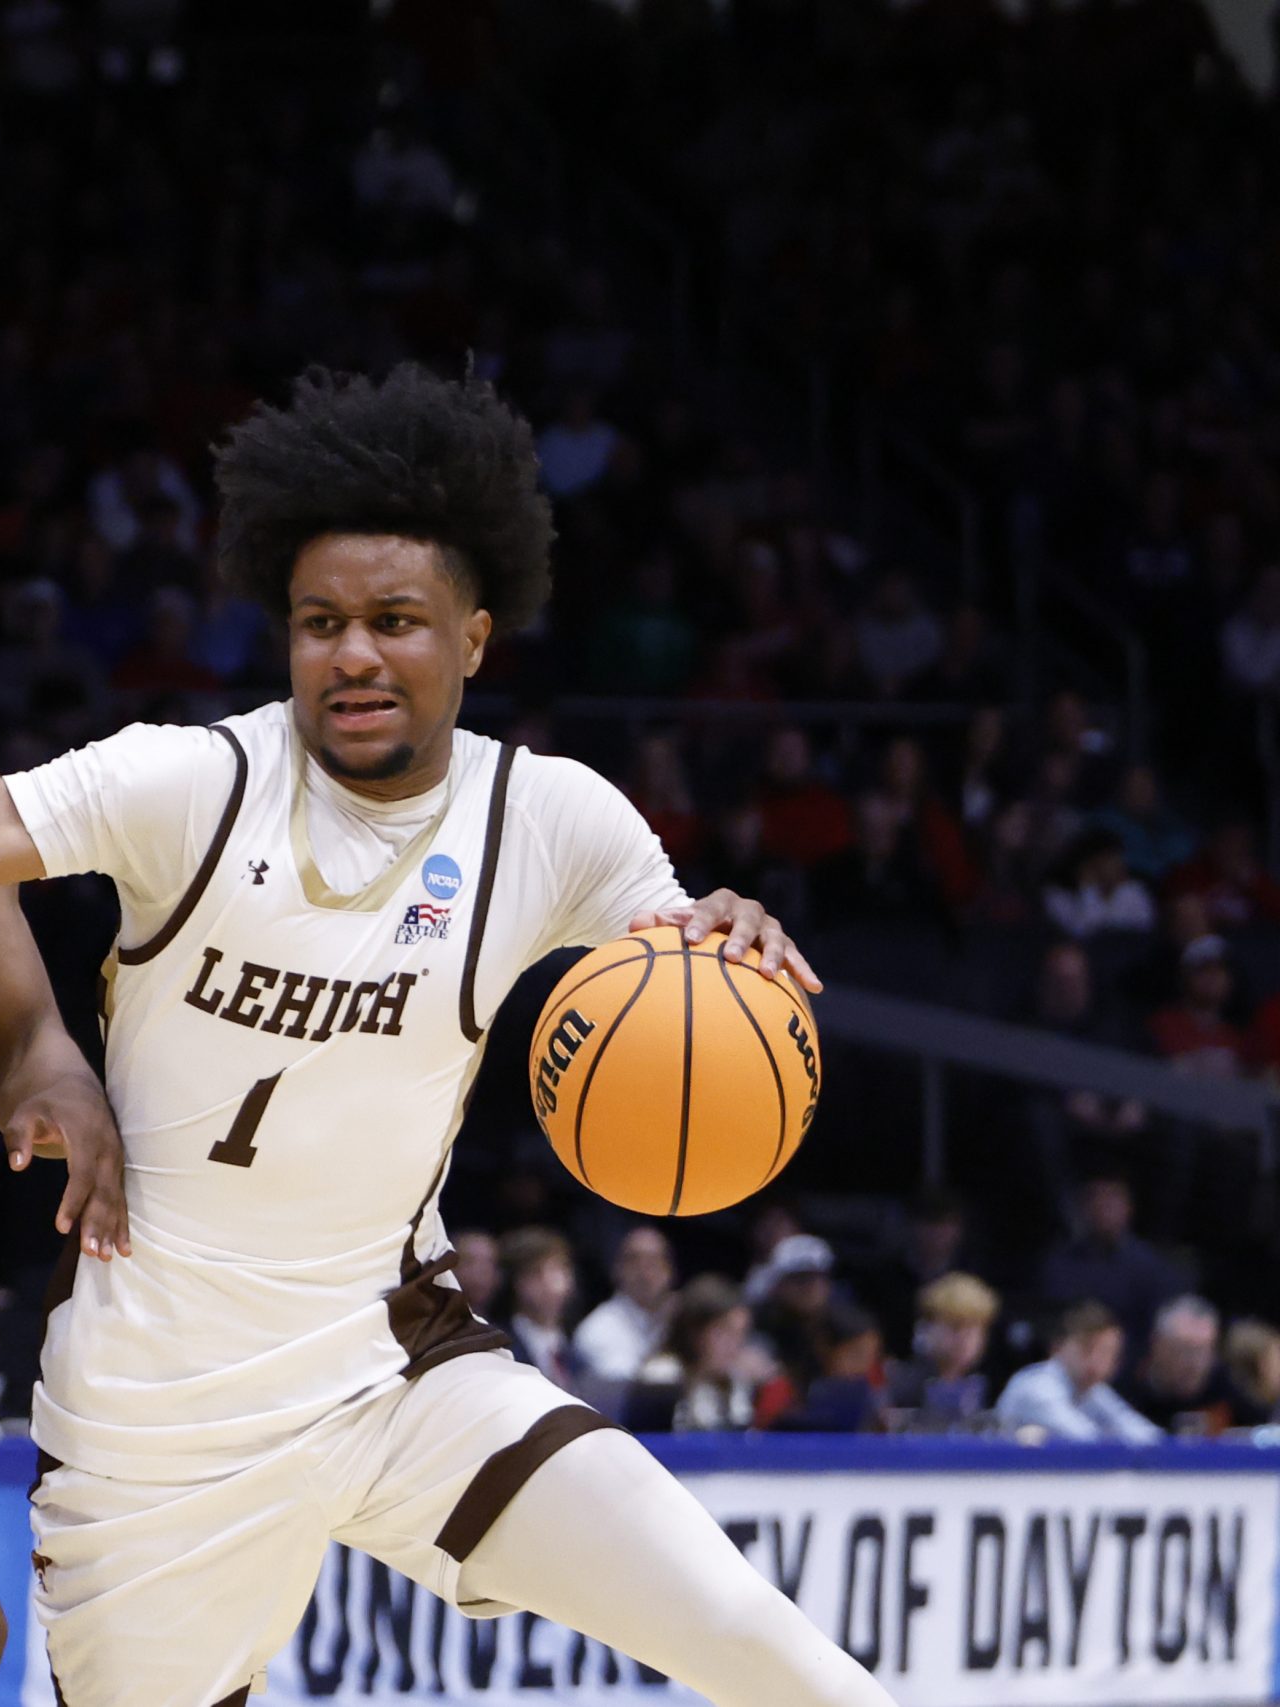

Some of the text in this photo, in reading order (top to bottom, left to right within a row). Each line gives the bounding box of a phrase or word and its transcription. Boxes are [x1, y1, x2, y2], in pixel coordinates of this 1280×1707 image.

[428, 872, 461, 890] NCAA
[207, 1067, 288, 1169] 1
[840, 1513, 936, 1672] OF
[964, 1511, 1245, 1671] DAYTON
